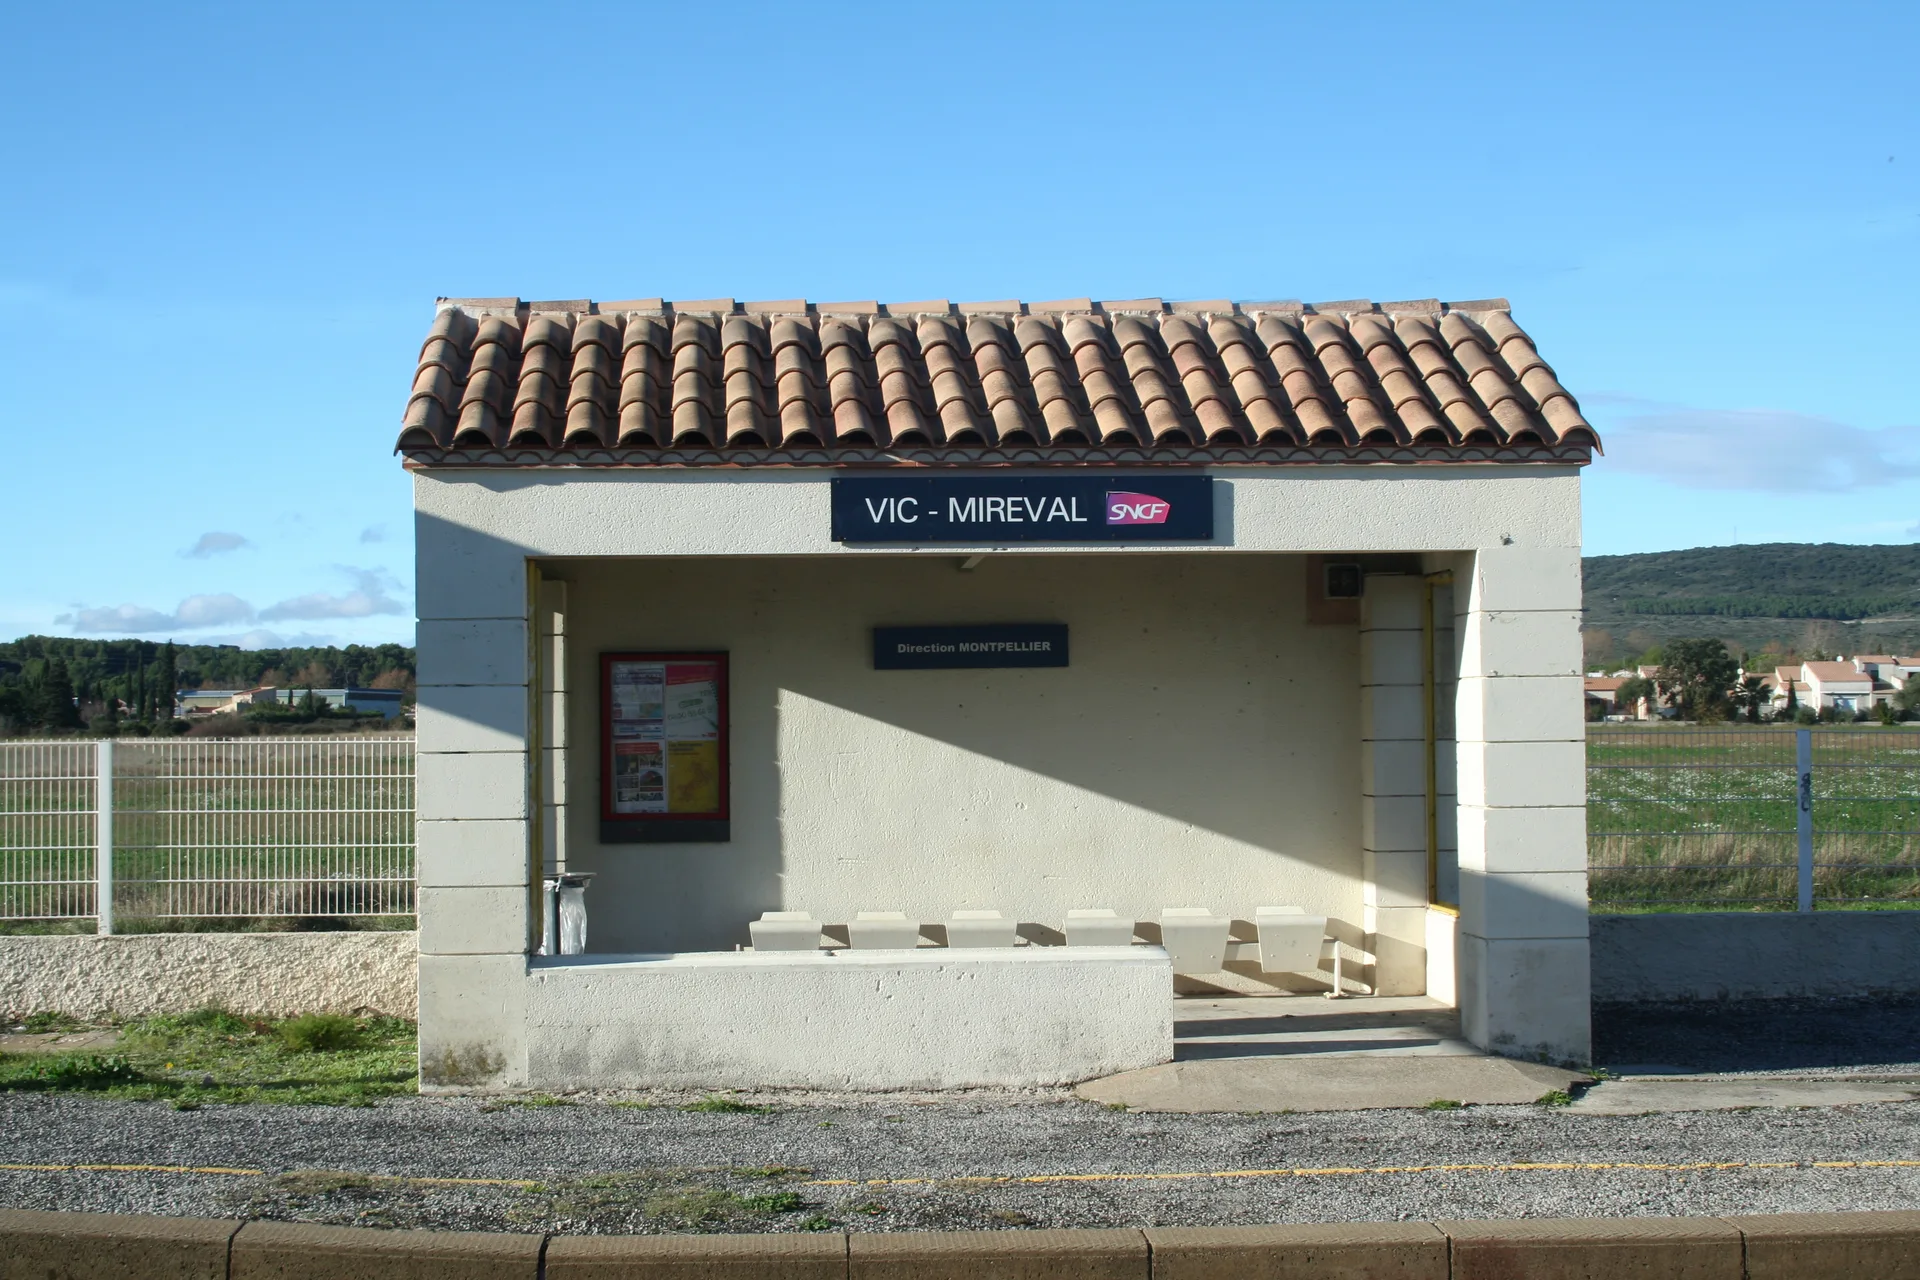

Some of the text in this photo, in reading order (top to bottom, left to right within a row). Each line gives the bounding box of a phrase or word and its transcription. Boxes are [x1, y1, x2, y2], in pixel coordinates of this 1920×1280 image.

[865, 497, 918, 523] VIC
[949, 496, 1088, 523] MIREVAL
[1109, 503, 1166, 520] SNCF
[897, 641, 1052, 654] Direction MONTPELLIER
